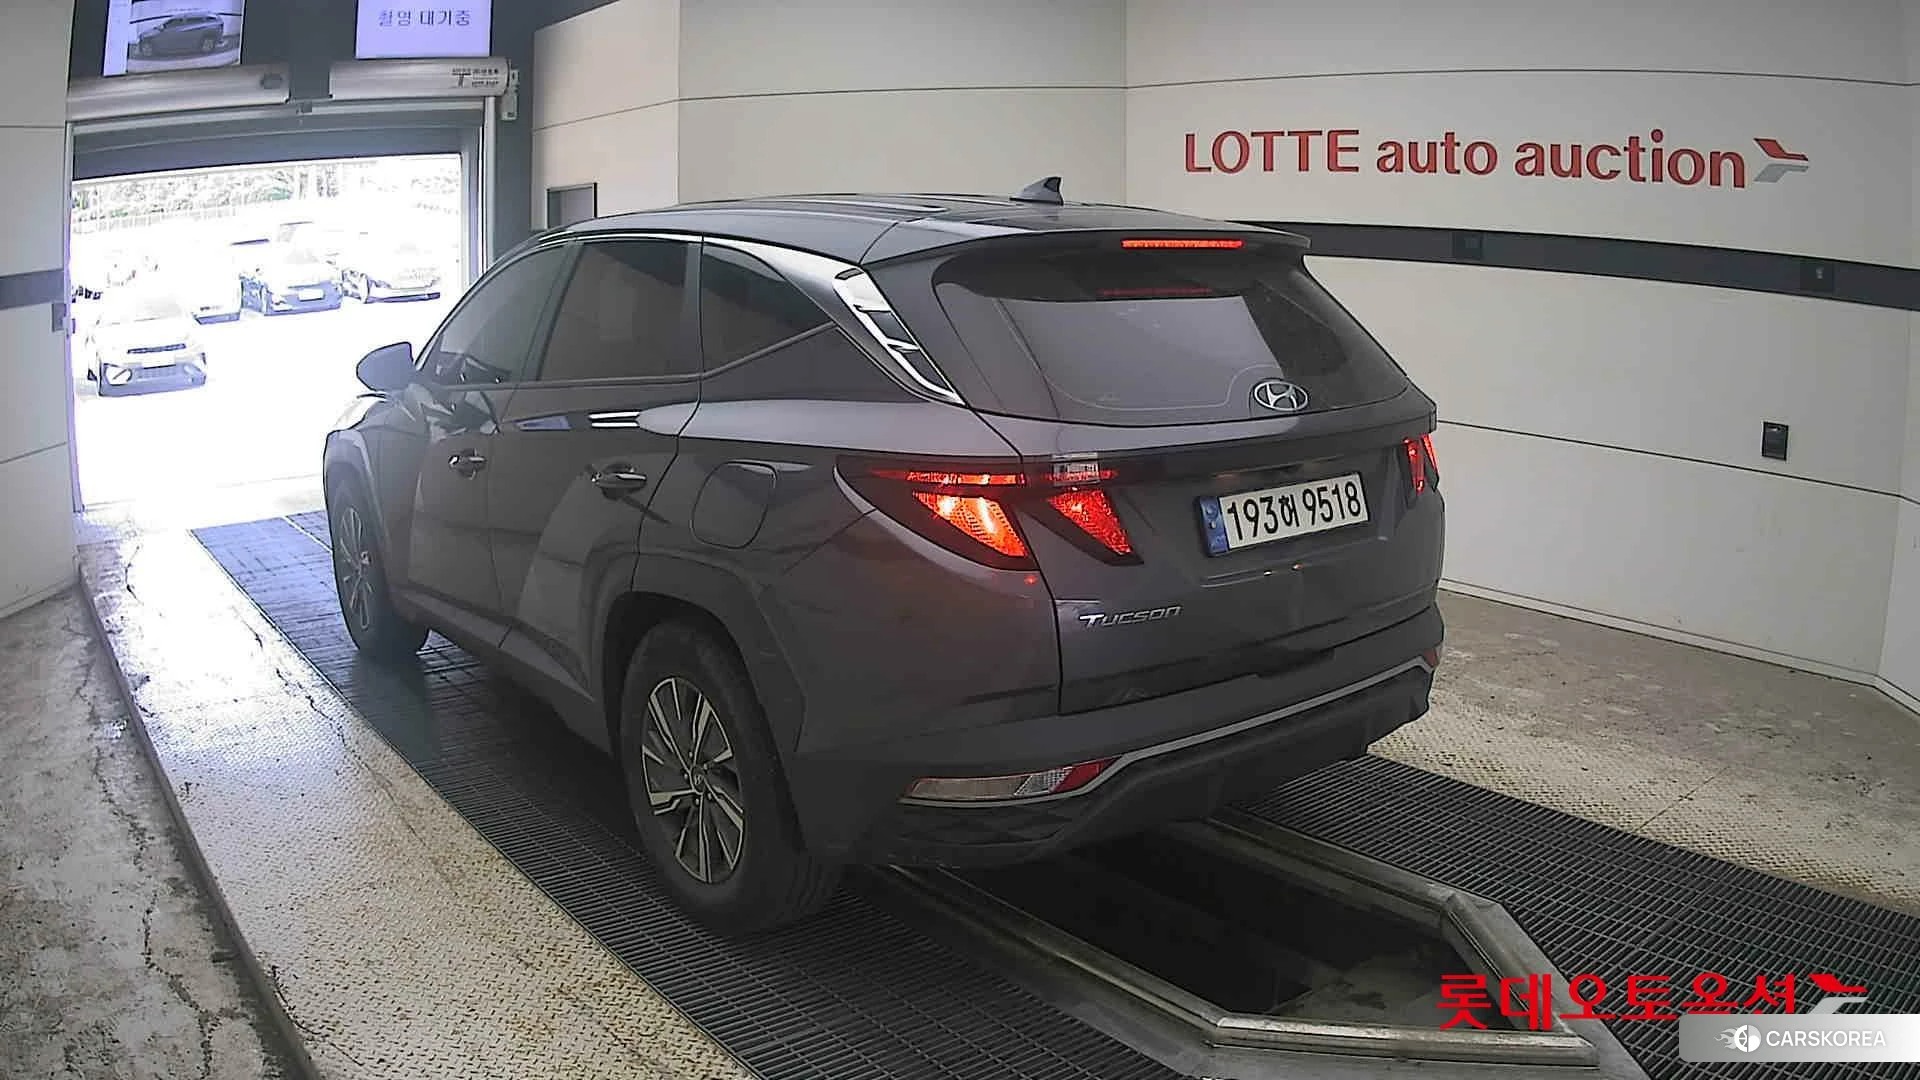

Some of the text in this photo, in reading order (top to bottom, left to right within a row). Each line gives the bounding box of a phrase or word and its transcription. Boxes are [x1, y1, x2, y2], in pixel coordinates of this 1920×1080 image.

[419, 9, 471, 26] 대기중
[1185, 129, 1745, 188] LOTTE auto auction
[1227, 481, 1362, 540] 193허 9518
